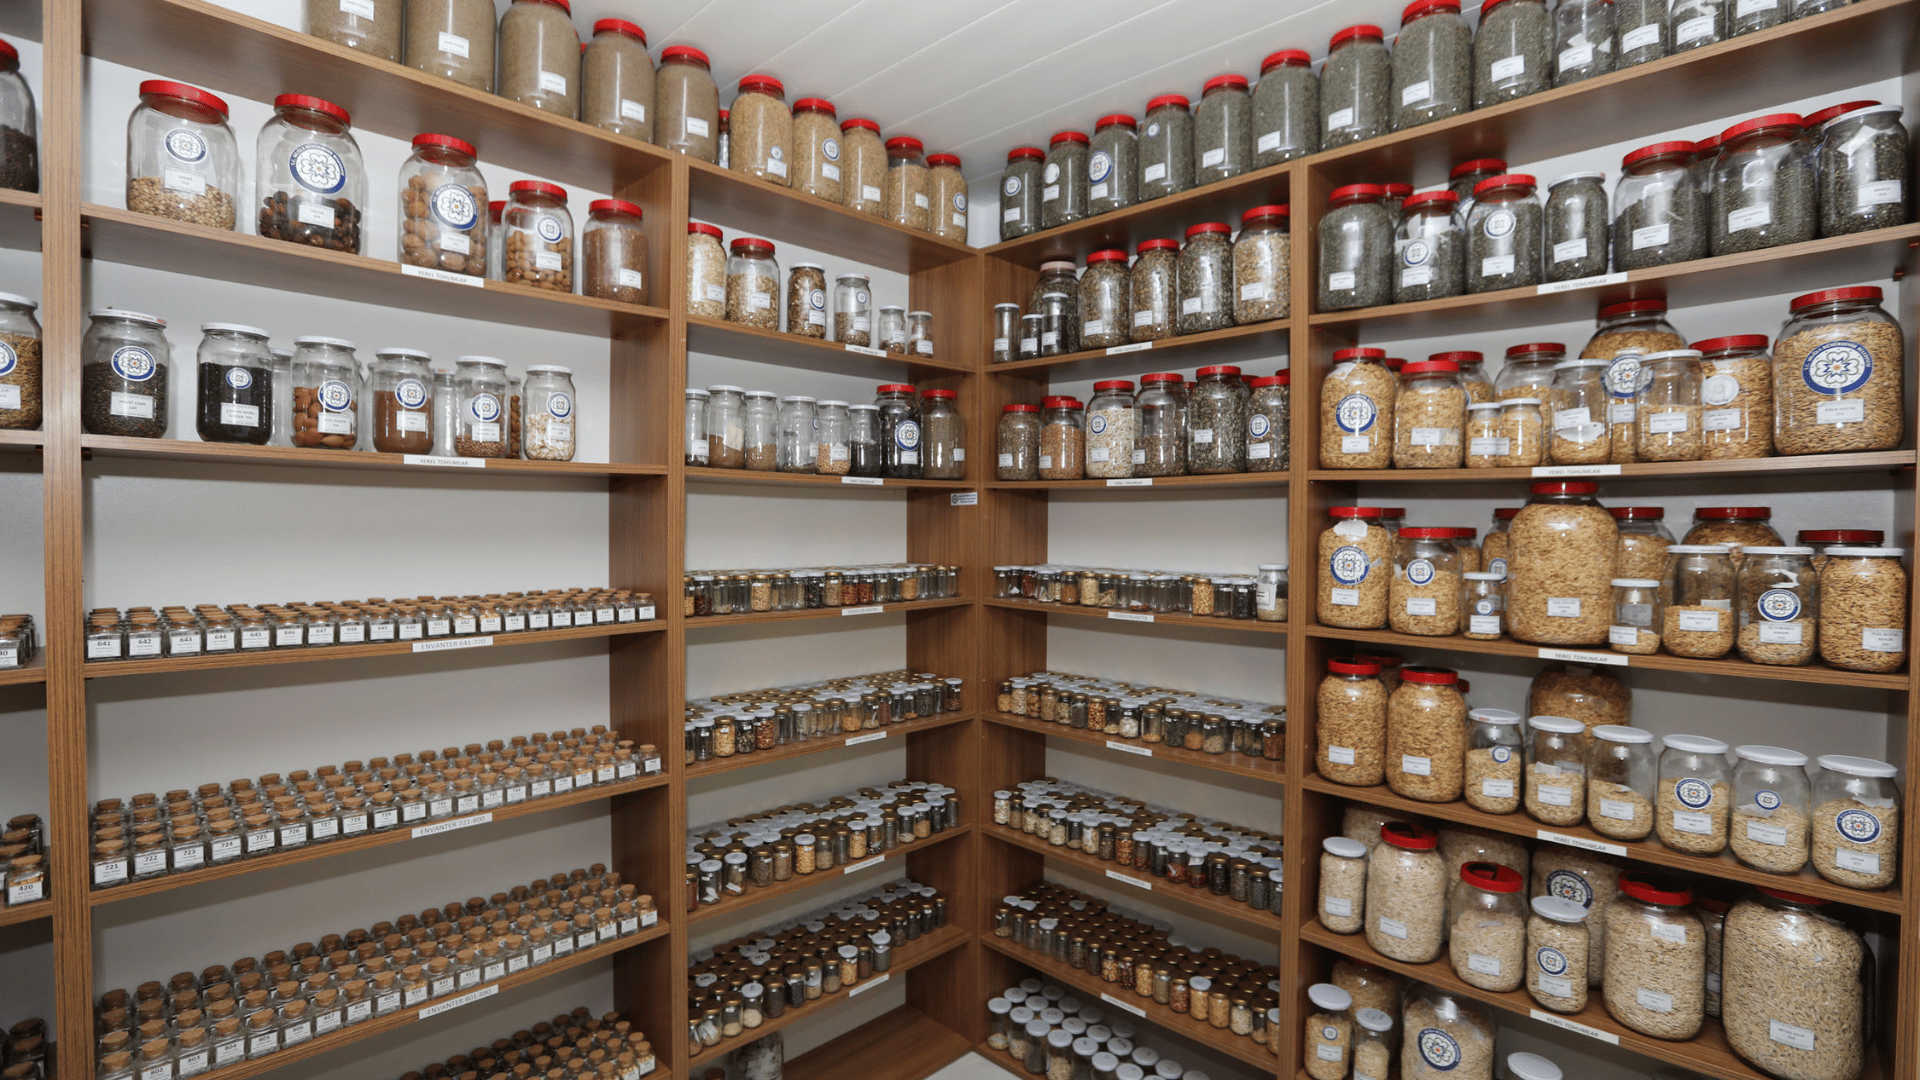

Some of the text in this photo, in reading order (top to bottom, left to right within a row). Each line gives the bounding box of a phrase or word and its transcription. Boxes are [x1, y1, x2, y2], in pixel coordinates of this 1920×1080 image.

[421, 638, 486, 650] ENVANTER 641-720
[420, 815, 485, 835] ENVANTER 721-800
[105, 863, 118, 871] 721
[18, 884, 34, 892] 420
[427, 998, 464, 1015] ENVANTER
[224, 1043, 237, 1051] 804
[187, 1055, 200, 1063] 803
[150, 1067, 164, 1076] 802
